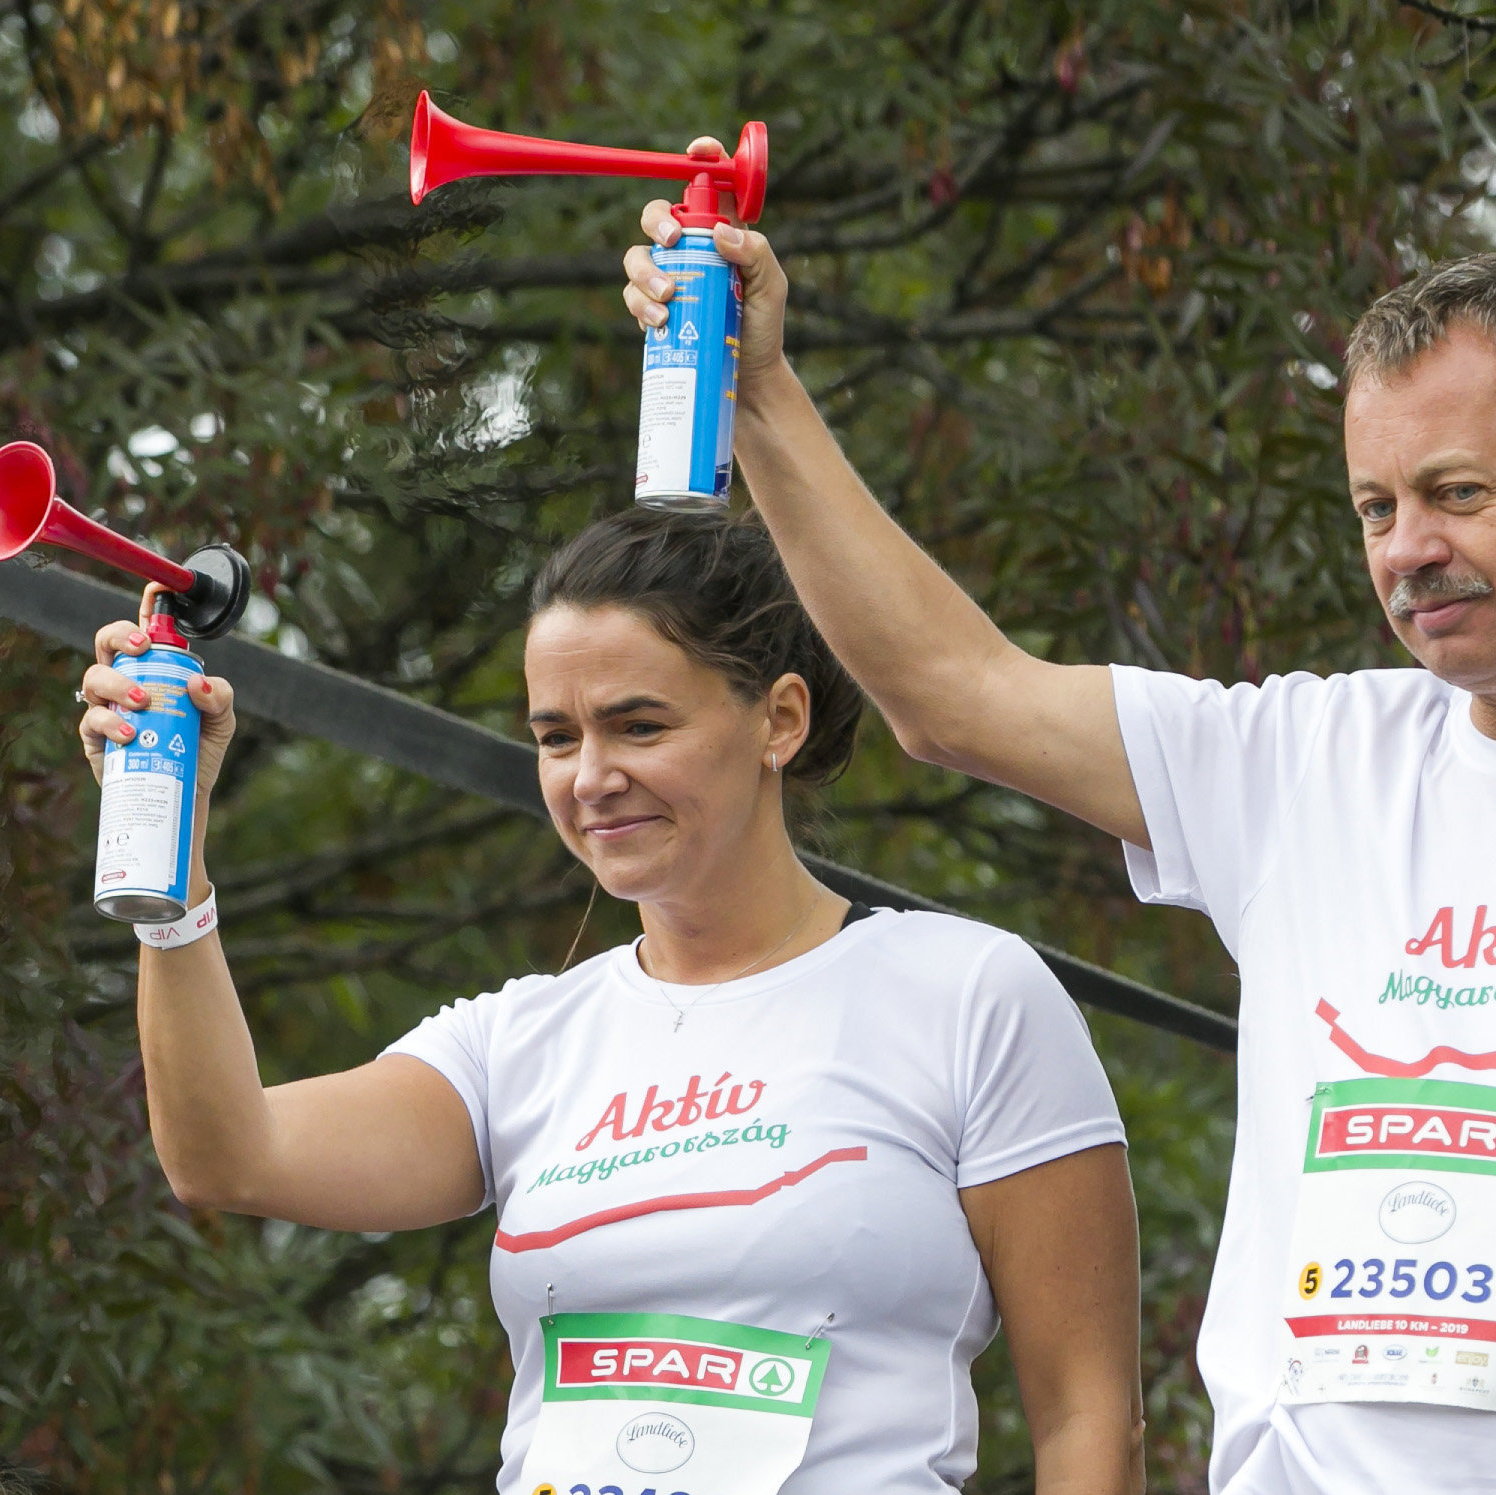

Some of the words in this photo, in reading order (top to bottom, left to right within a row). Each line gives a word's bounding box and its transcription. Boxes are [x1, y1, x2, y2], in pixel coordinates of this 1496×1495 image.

[574, 1071, 768, 1152] Aktív
[526, 1118, 793, 1195] Magyarország
[1304, 1267, 1320, 1295] 5
[1330, 1257, 1494, 1304] 23503
[1337, 1319, 1393, 1331] LANDLIEBE
[1395, 1320, 1408, 1330] 10
[1410, 1321, 1429, 1331] KM
[1439, 1322, 1469, 1334] 2019
[591, 1348, 736, 1385] SPAR
[626, 1420, 688, 1449] Landliebe
